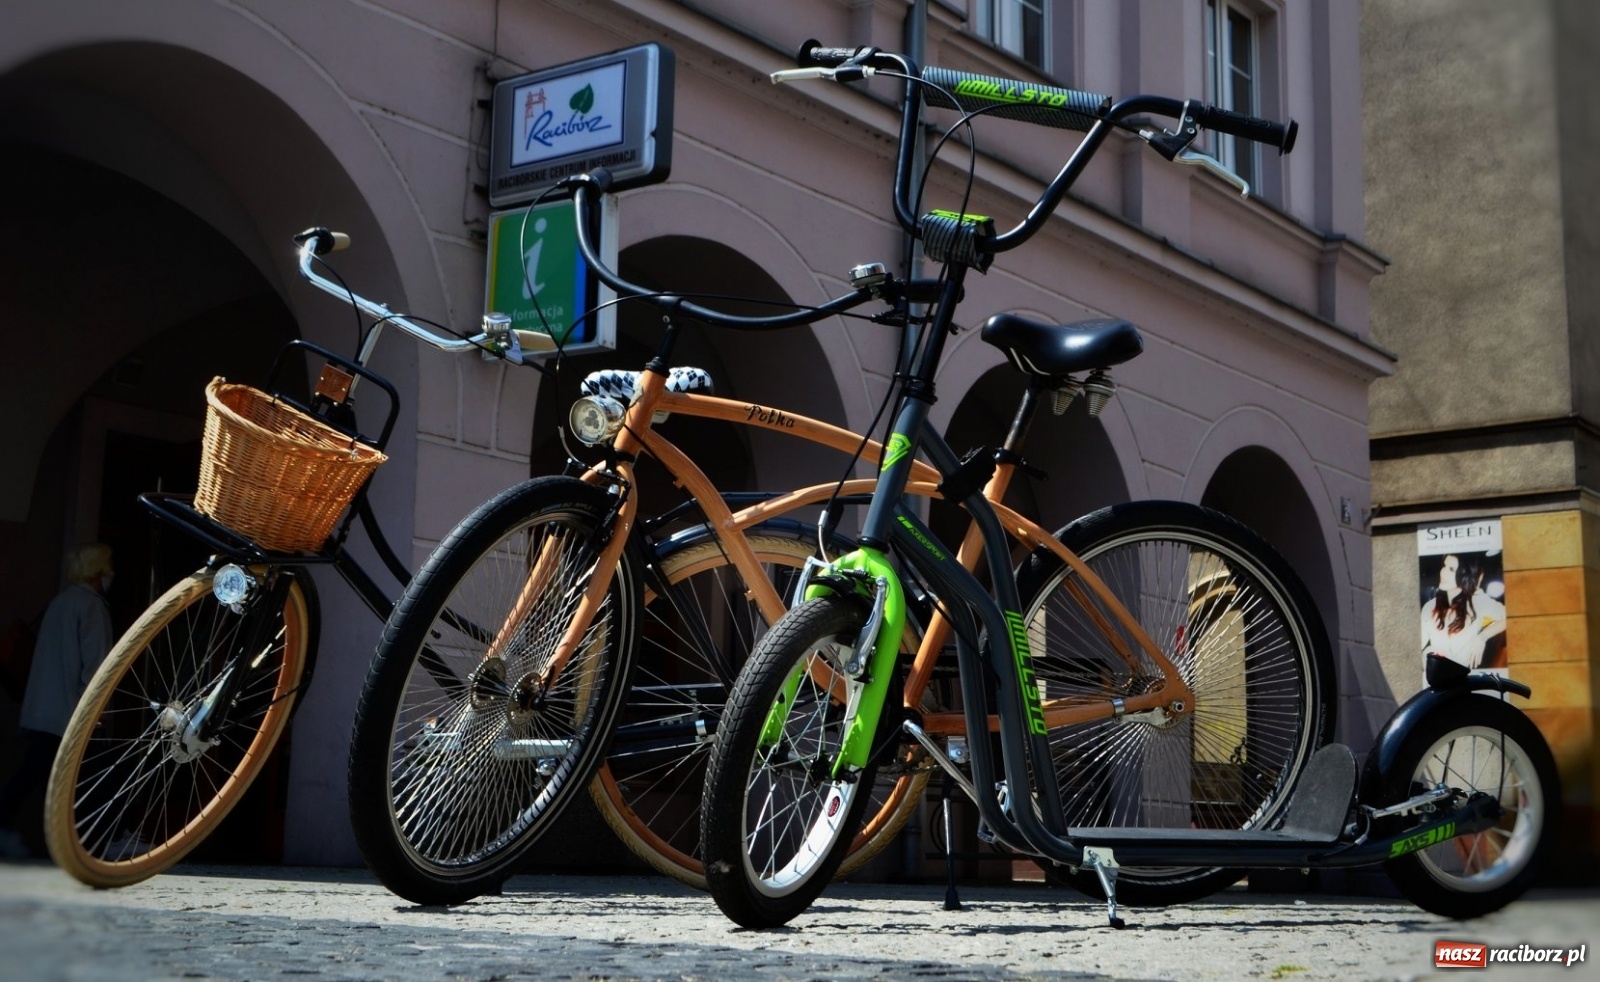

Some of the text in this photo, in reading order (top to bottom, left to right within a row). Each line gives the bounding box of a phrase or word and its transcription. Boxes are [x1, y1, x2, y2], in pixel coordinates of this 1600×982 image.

[549, 161, 587, 179] CENTRUM
[588, 149, 637, 170] INFORMACJI
[1426, 525, 1492, 541] SHEEN
